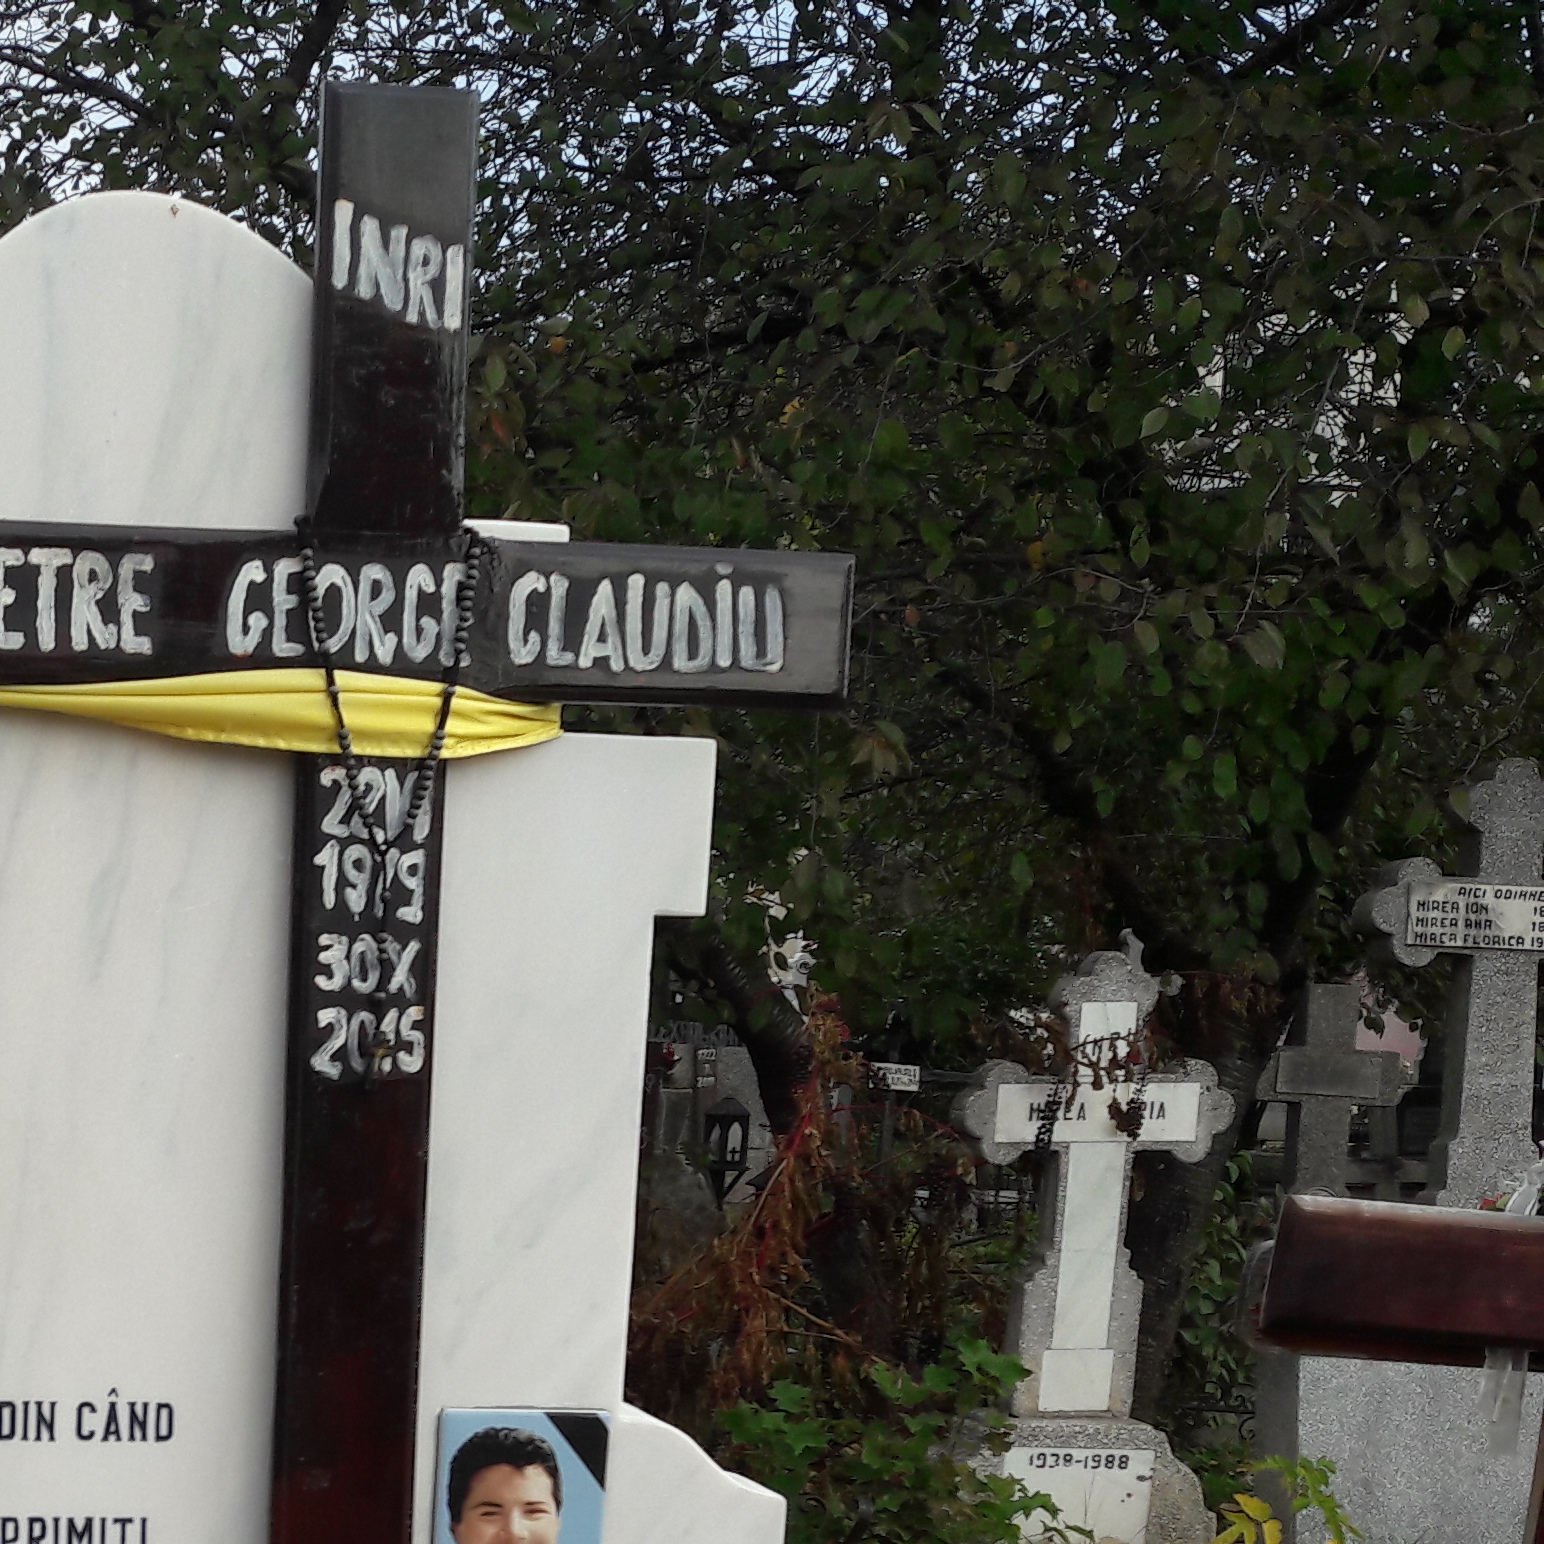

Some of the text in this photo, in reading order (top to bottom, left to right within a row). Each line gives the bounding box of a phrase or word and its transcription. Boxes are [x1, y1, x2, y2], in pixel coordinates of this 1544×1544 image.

[331, 198, 465, 332] INRI
[1416, 901, 1459, 914] MIREA
[1465, 902, 1489, 915] ION
[1415, 916, 1458, 928] MIREA
[1414, 932, 1458, 945] MIREA
[1463, 933, 1525, 947] FLORICA
[75, 1387, 176, 1443] CÂND
